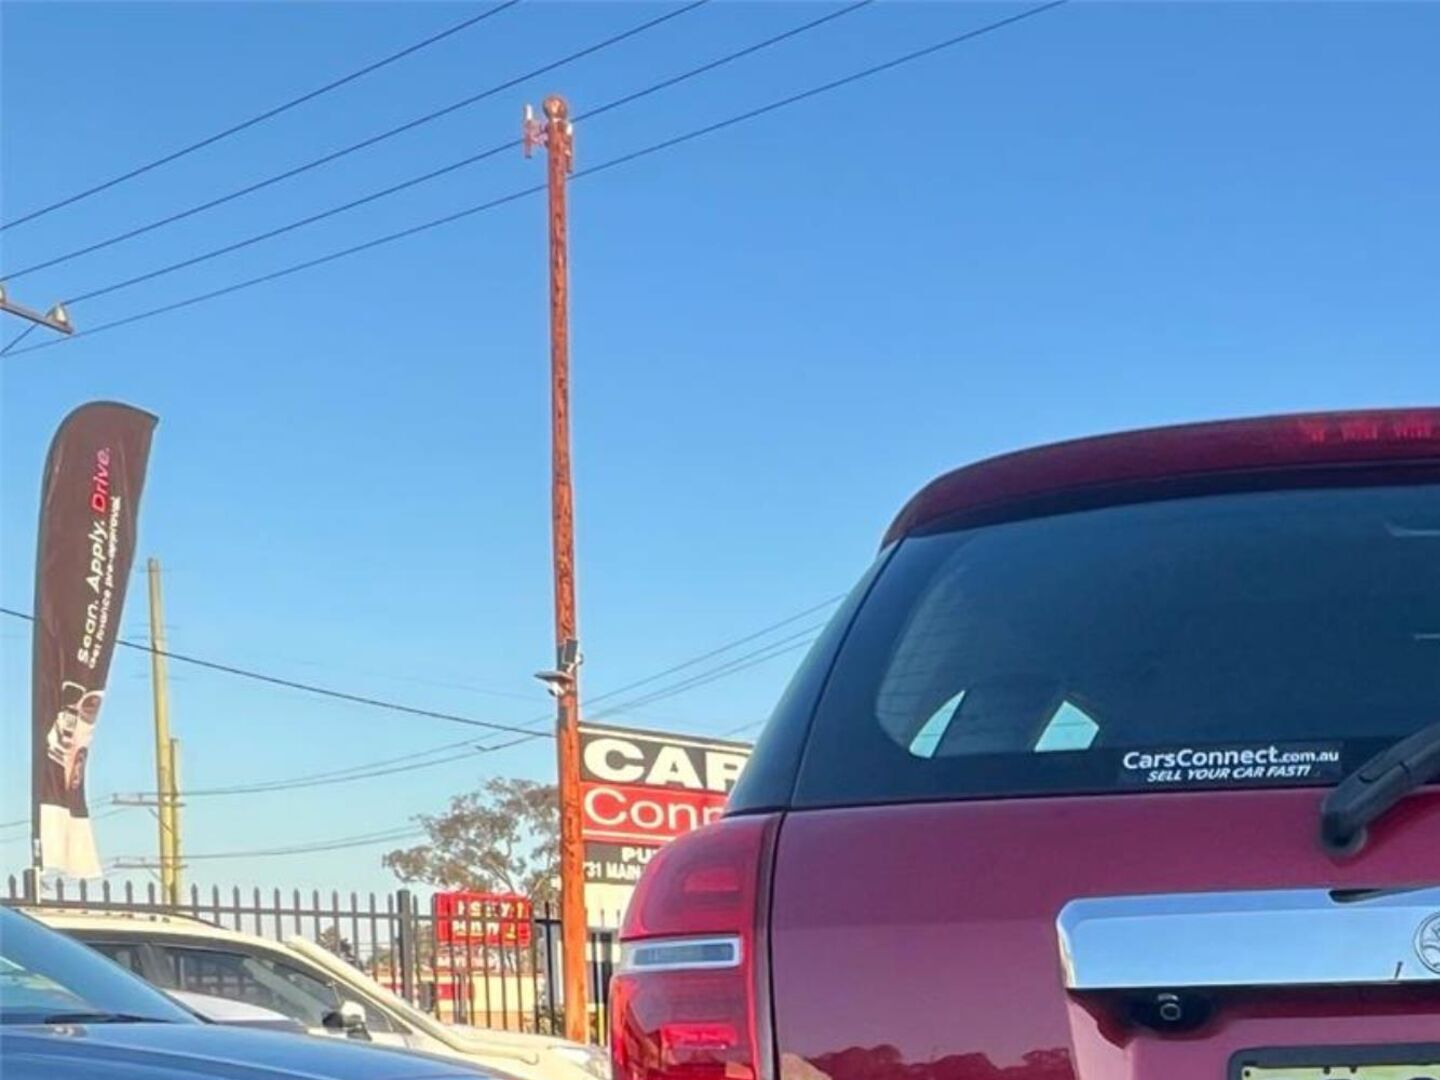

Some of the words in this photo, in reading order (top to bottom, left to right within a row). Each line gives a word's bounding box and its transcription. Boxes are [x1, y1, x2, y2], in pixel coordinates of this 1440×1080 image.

[92, 447, 110, 513] Drive.
[86, 521, 108, 594] Apply.
[1123, 746, 1339, 769] CarsConnect.com.au
[1147, 769, 1182, 782] SELL
[1187, 766, 1230, 780] YOUR
[1232, 765, 1264, 778] CAR
